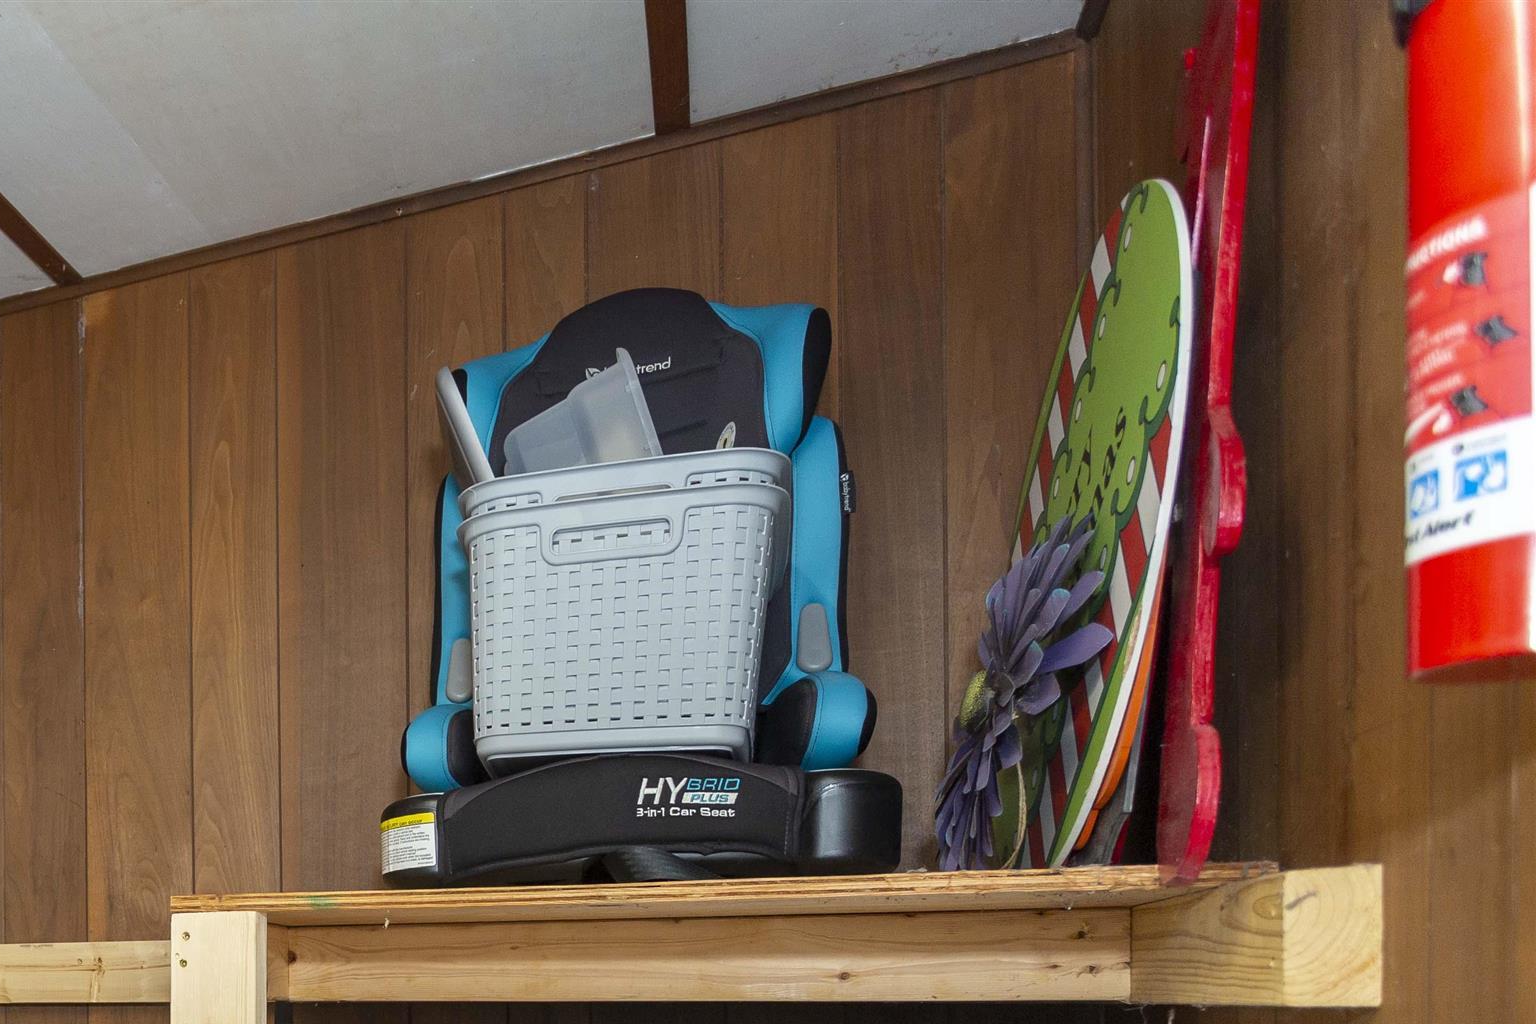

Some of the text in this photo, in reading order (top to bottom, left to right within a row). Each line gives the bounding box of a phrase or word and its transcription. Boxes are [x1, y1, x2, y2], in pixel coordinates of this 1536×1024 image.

[690, 793, 730, 803] PLUS
[636, 807, 736, 818] 3-in-1 Car Seat
